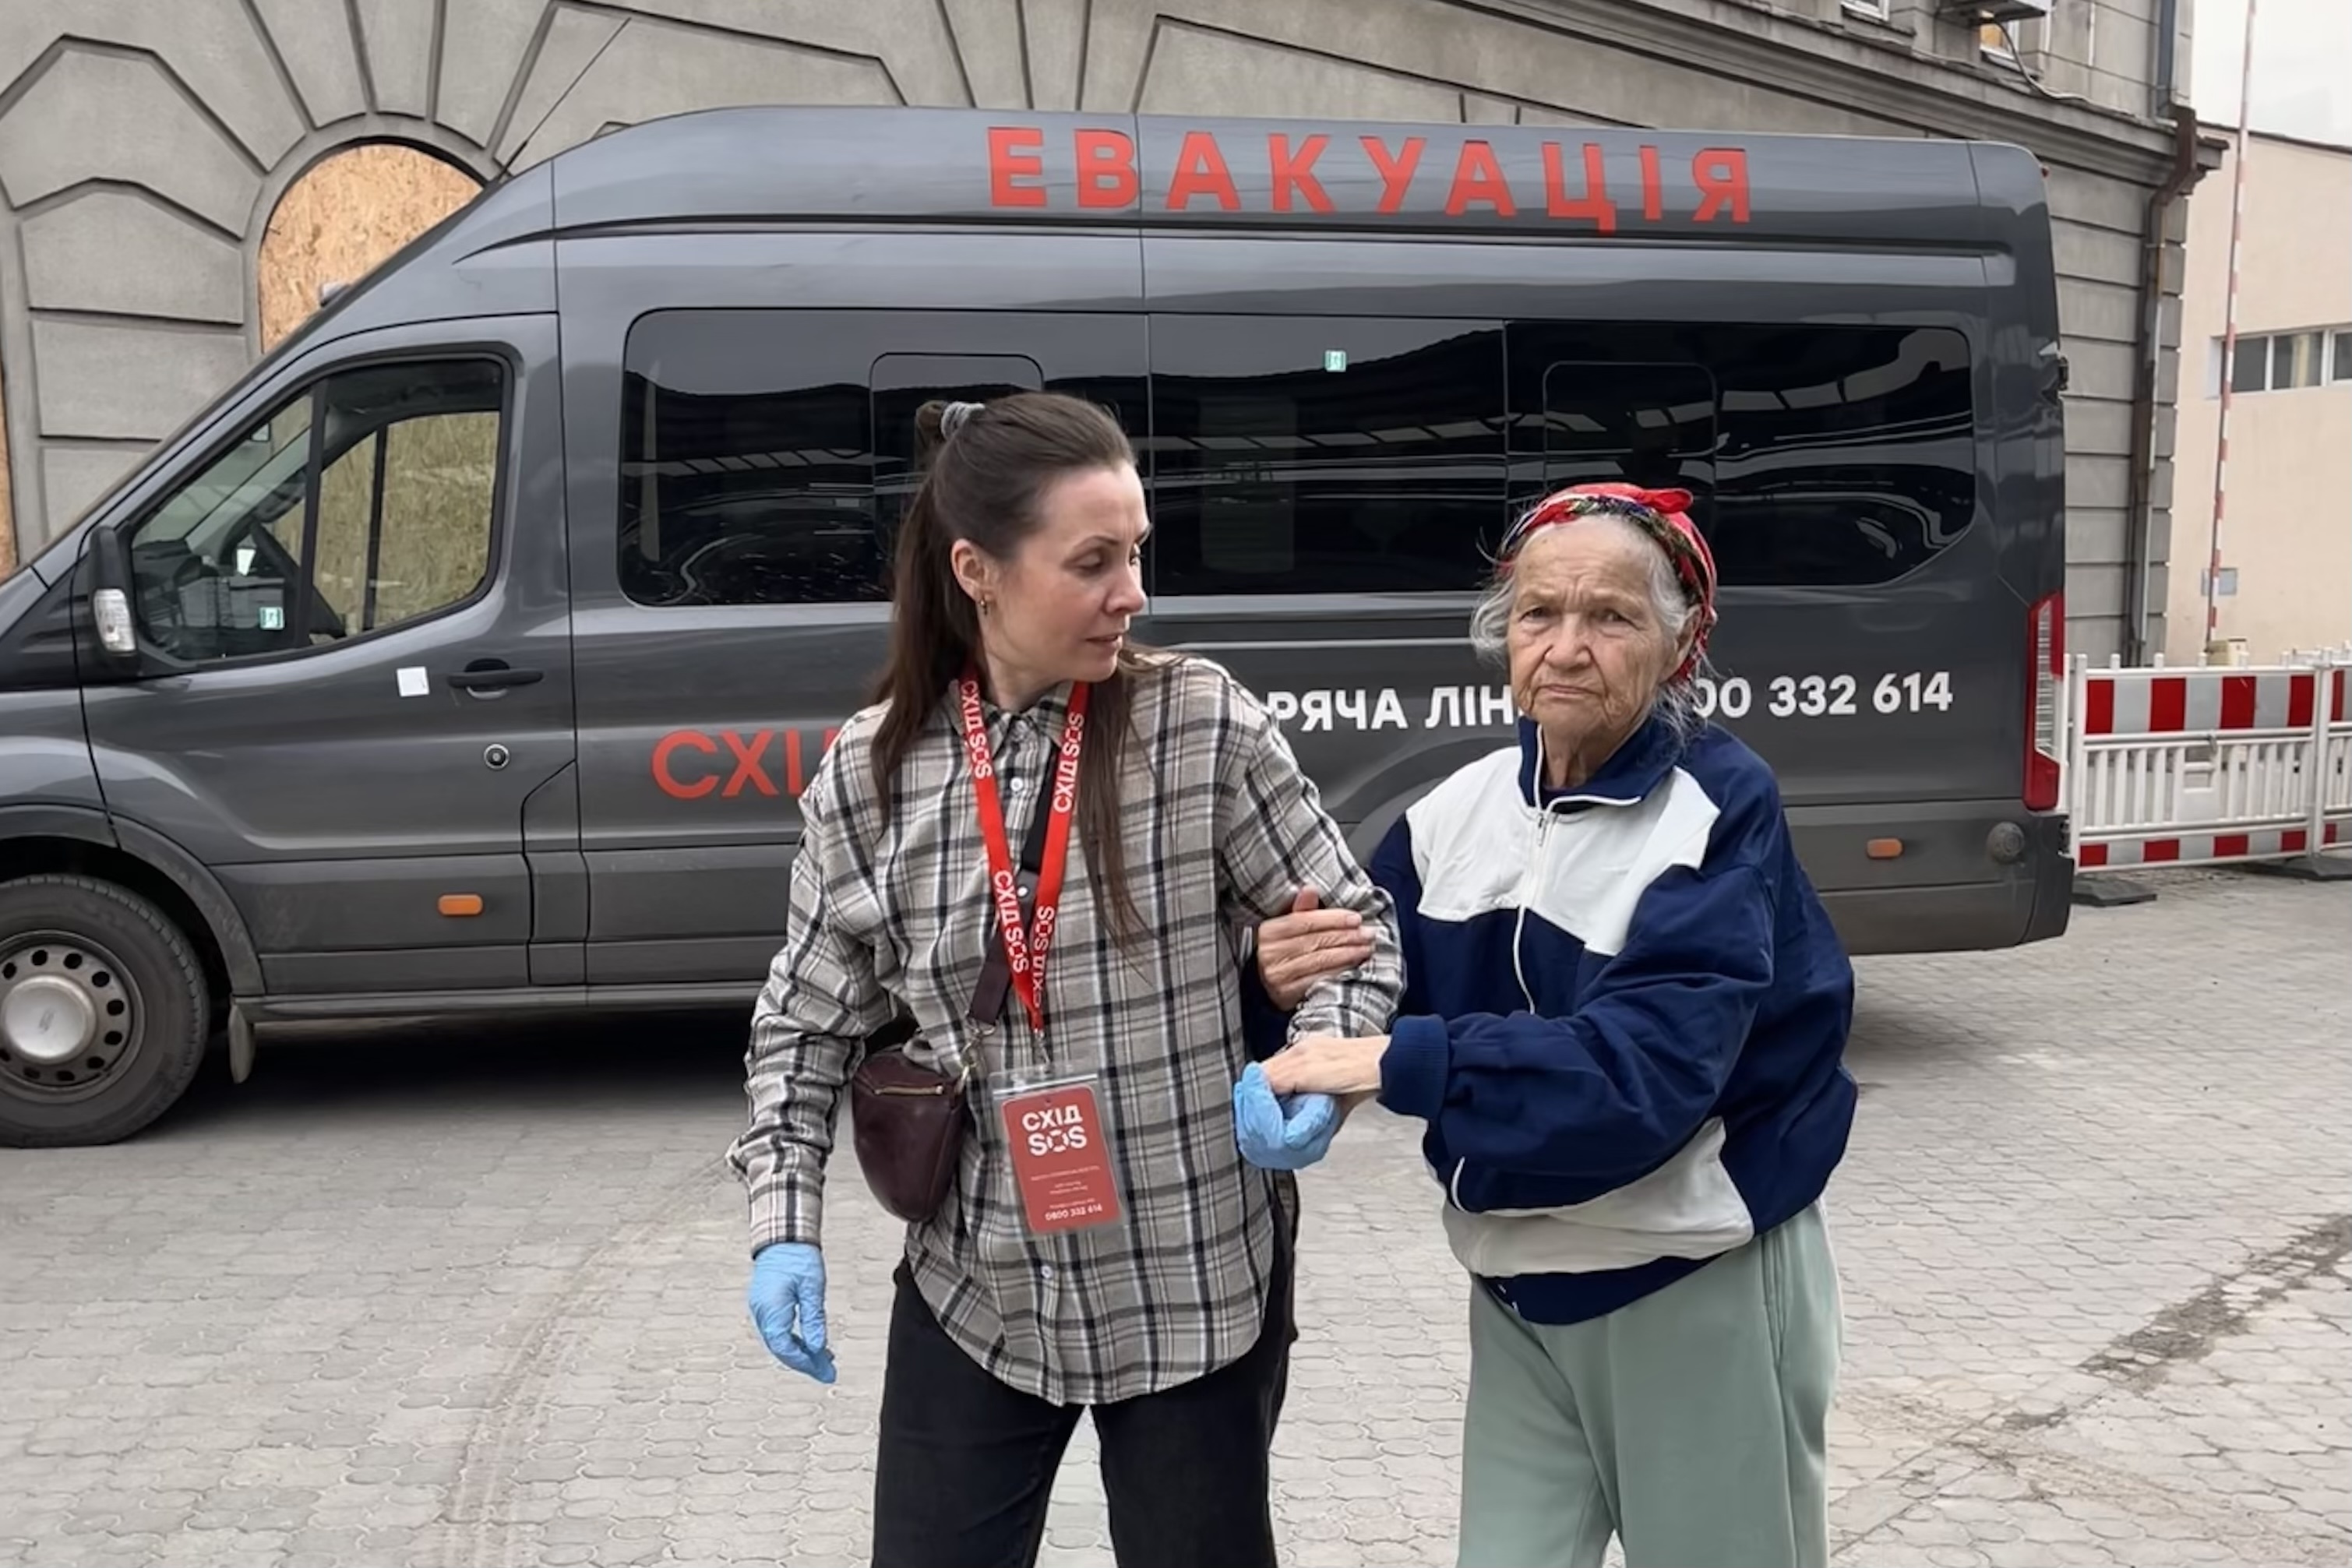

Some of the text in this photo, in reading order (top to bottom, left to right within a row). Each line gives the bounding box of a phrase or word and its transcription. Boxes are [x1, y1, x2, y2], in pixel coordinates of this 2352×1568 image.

[986, 127, 1751, 235] ЕВАКУАЦІЯ
[1768, 674, 1857, 717] 332
[1872, 671, 1953, 714] 614
[651, 728, 842, 799] СХІ
[961, 681, 993, 779] СХІД SOS
[1053, 712, 1084, 812] СХІД SOS
[994, 870, 1029, 973] СХІД SOS
[1034, 905, 1055, 950] SOS
[1022, 1105, 1083, 1132] СХІД
[1028, 1126, 1088, 1157] SOS
